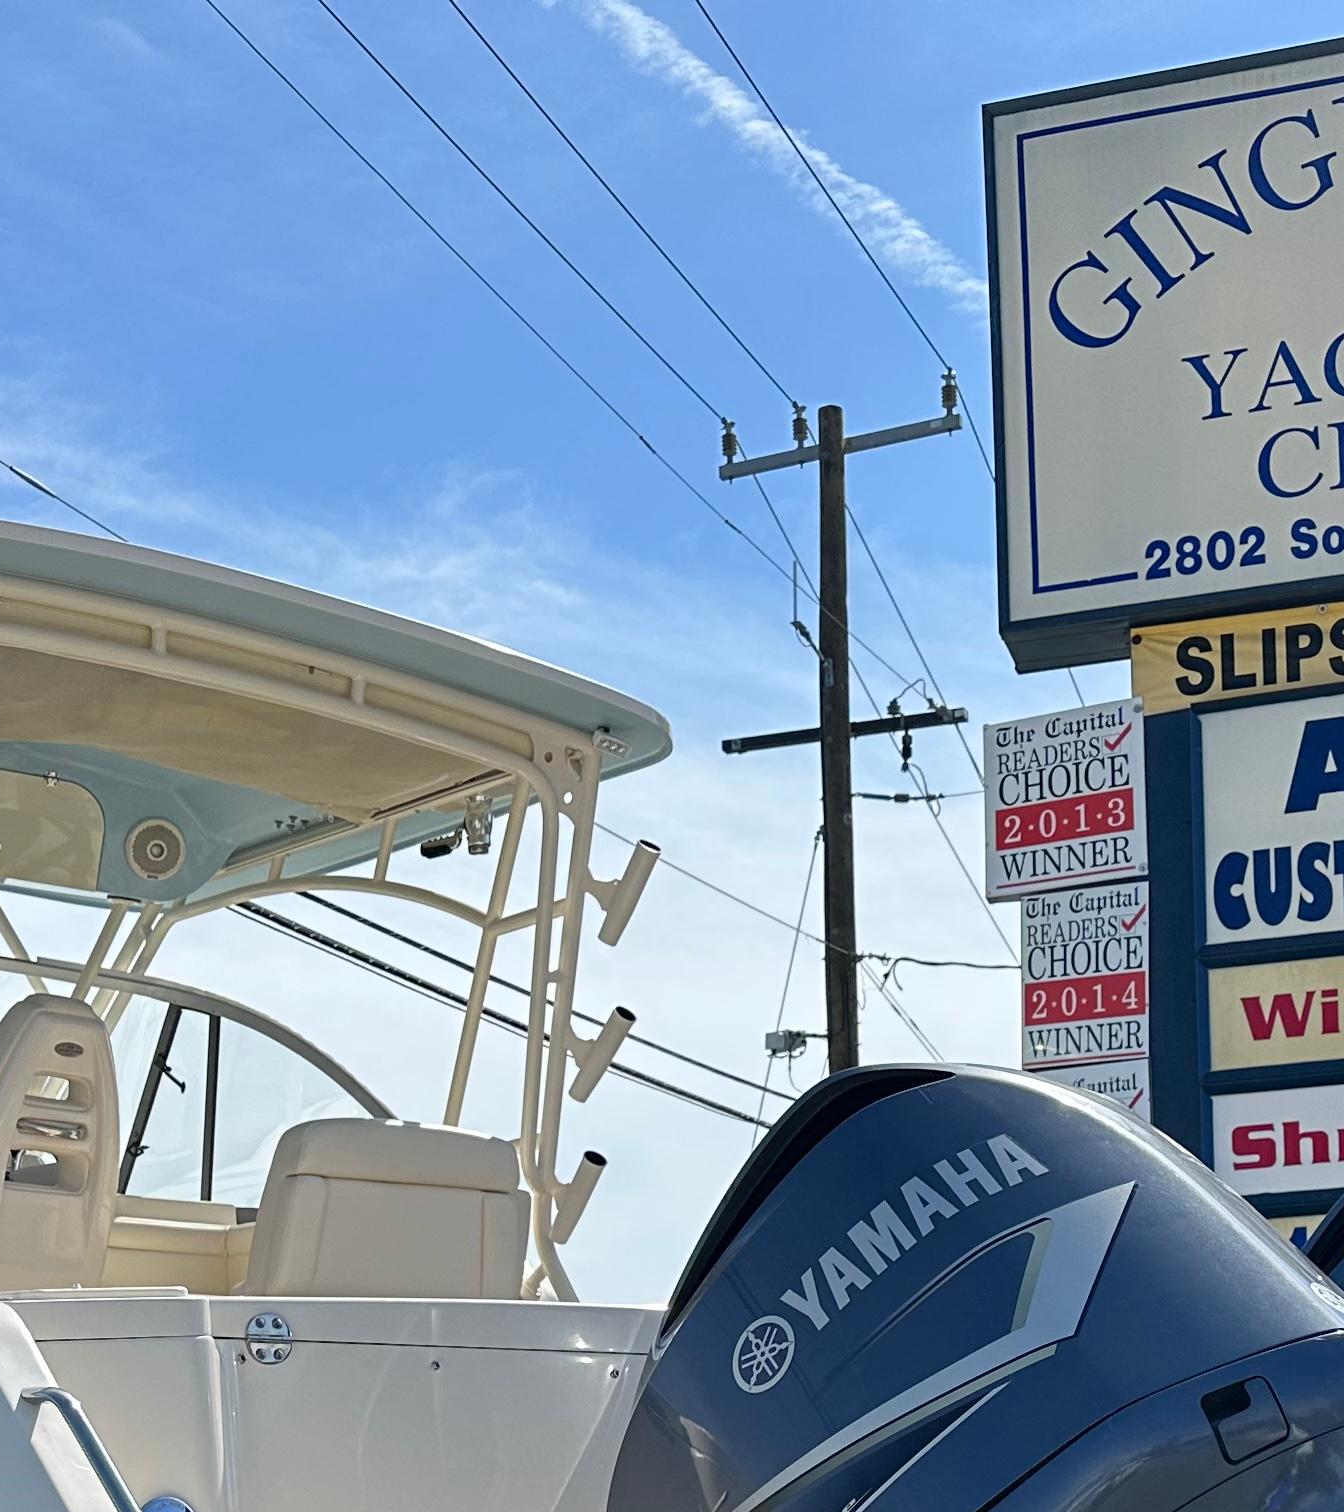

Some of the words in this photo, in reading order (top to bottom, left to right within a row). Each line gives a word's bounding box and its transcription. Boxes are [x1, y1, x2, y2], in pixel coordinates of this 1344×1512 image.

[1143, 527, 1267, 581] 2802
[996, 725, 1036, 748] The
[1045, 706, 1125, 739] Capital
[997, 736, 1101, 775] READERS
[998, 753, 1131, 807] CHOICE
[1000, 836, 1133, 882] WINNER
[1025, 897, 1062, 920] The
[1069, 886, 1141, 915] Capital
[1026, 914, 1119, 947] READERS
[1027, 936, 1144, 981] CHOICE
[1028, 1020, 1144, 1058] WINNER
[780, 1133, 1050, 1332] YAMAHA
